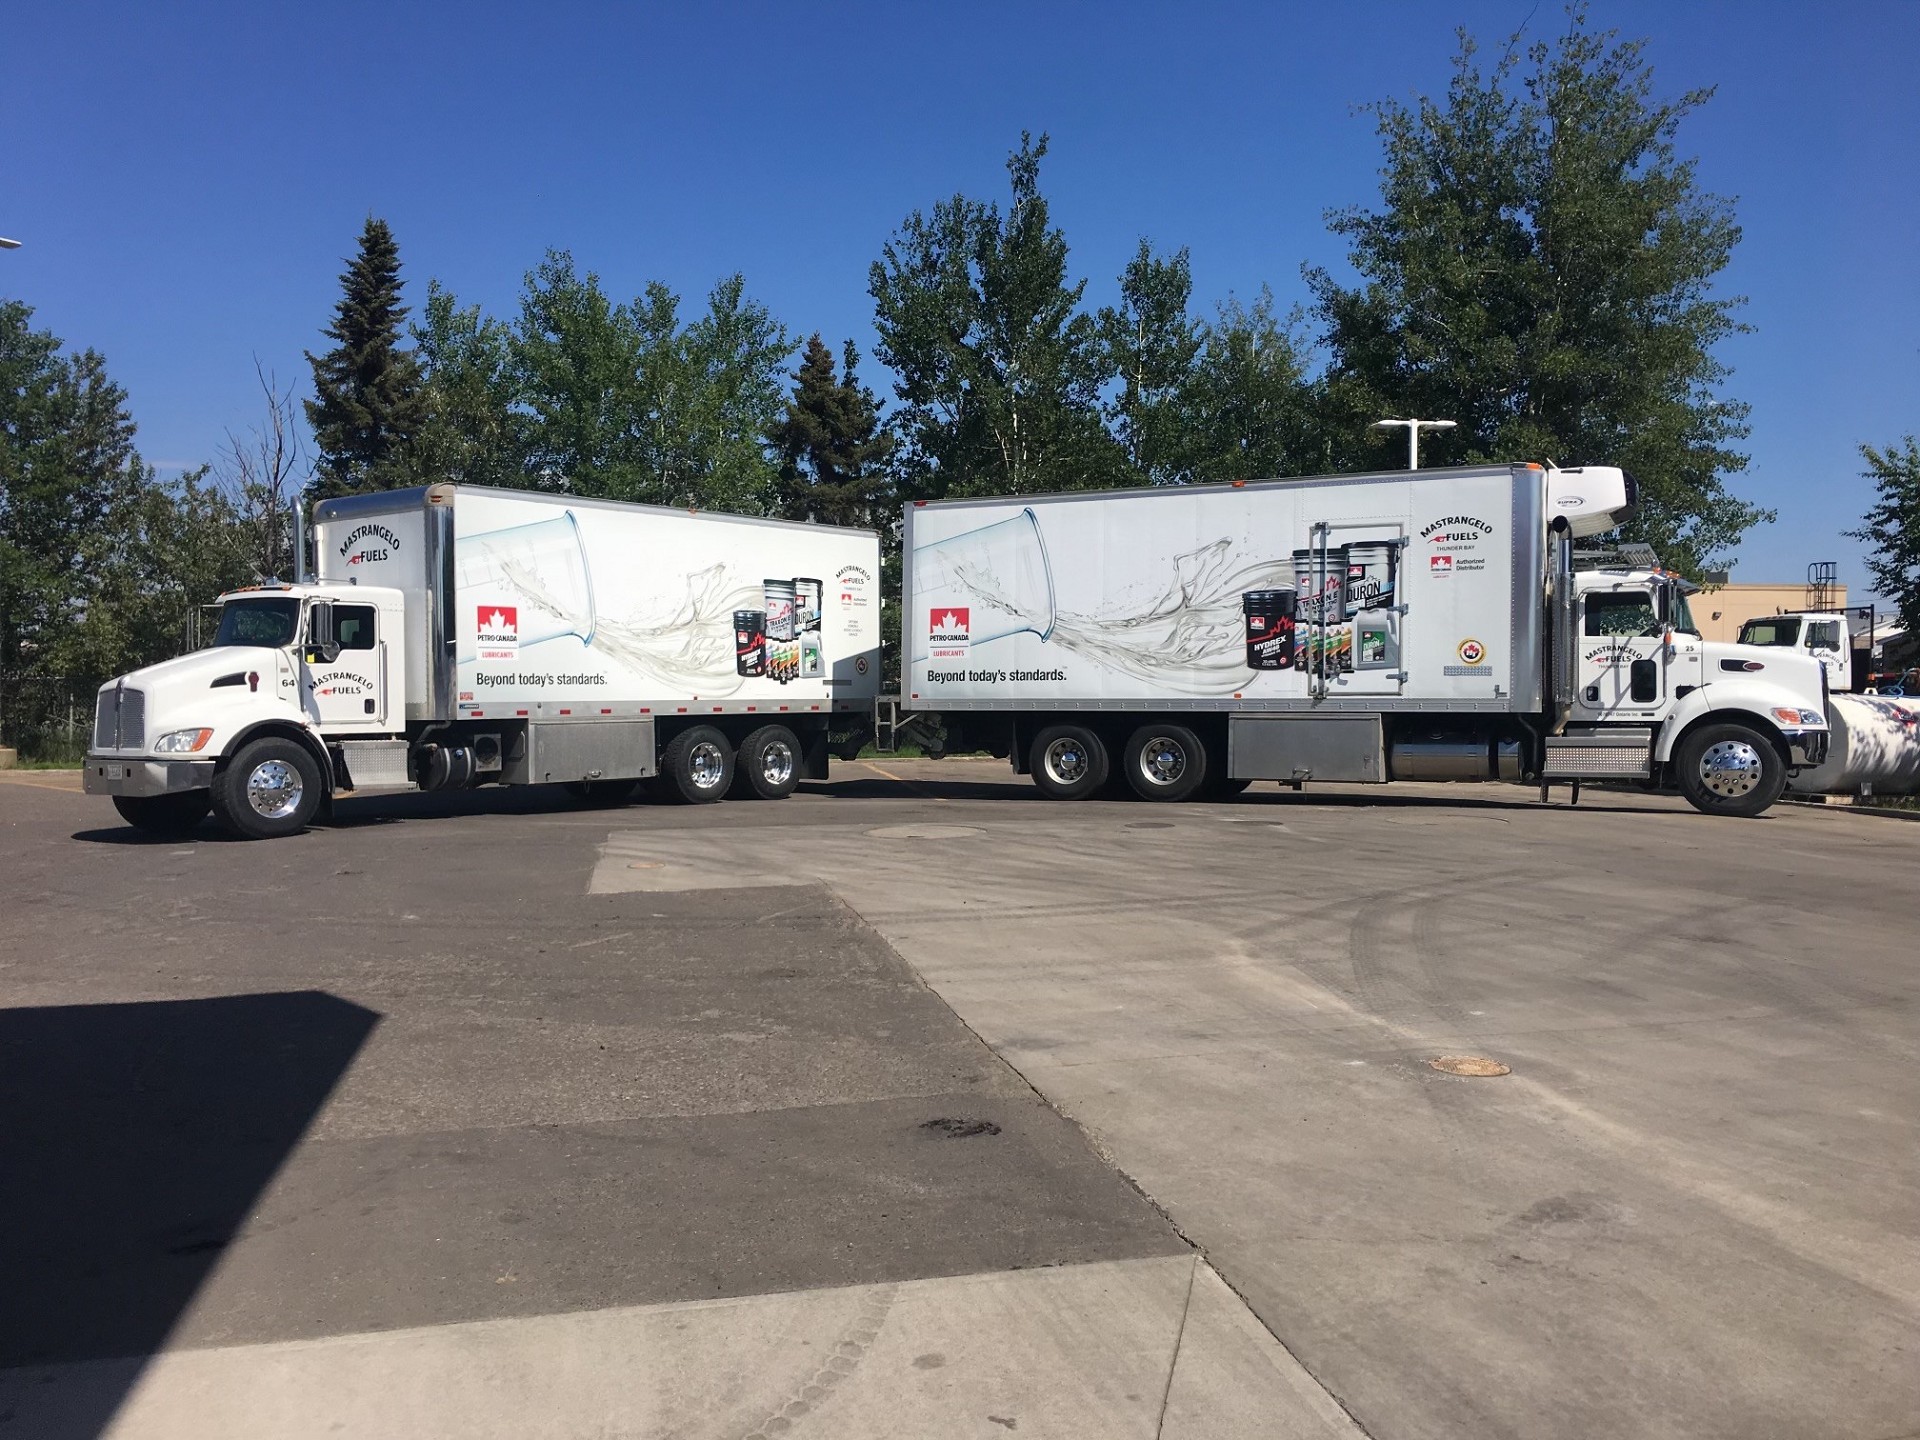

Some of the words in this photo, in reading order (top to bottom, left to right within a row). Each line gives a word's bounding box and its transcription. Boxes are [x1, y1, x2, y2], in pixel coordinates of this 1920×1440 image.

[1420, 516, 1493, 538] MASTRANGELO
[339, 524, 400, 557] MASTRANGELO
[1446, 532, 1478, 541] FUELS
[360, 549, 388, 563] FUELS
[835, 565, 871, 581] MASTRANGELO
[1347, 581, 1381, 601] DURON
[1254, 634, 1287, 651] HYDREX
[1584, 645, 1643, 661] MASTRANGELO
[1606, 655, 1632, 663] FUELS
[282, 679, 295, 687] 64
[308, 672, 373, 691] MASTRANGELO
[476, 673, 515, 688] Beyond
[519, 673, 554, 688] today's
[557, 673, 608, 685] standards.
[927, 670, 966, 684] Beyond
[968, 670, 1007, 683] today's
[1009, 669, 1068, 681] standards.
[332, 686, 361, 694] FUELS
